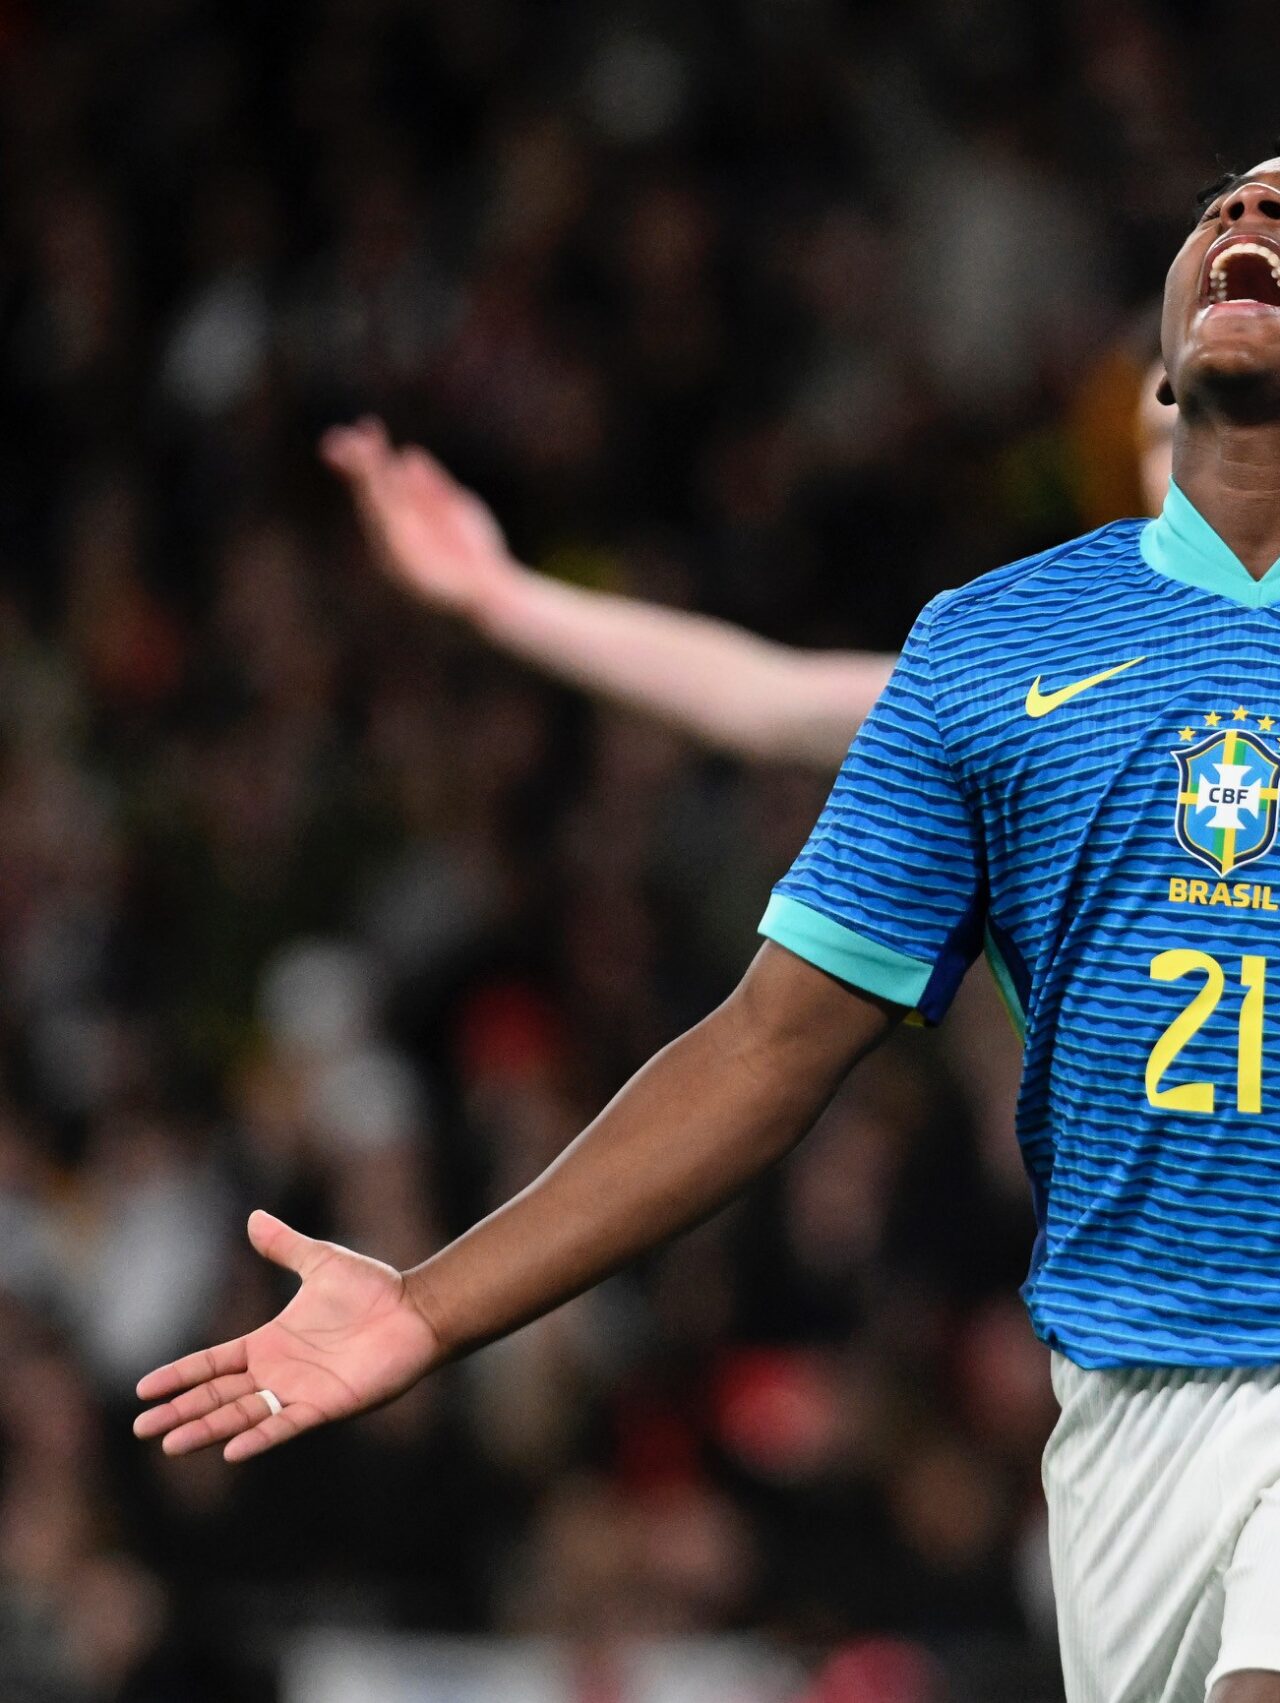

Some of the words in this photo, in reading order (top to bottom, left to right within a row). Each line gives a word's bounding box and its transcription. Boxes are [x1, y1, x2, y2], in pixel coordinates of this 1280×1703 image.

[1208, 787, 1249, 805] CBF
[1168, 877, 1279, 911] BRASIL
[1145, 948, 1267, 1114] 21
